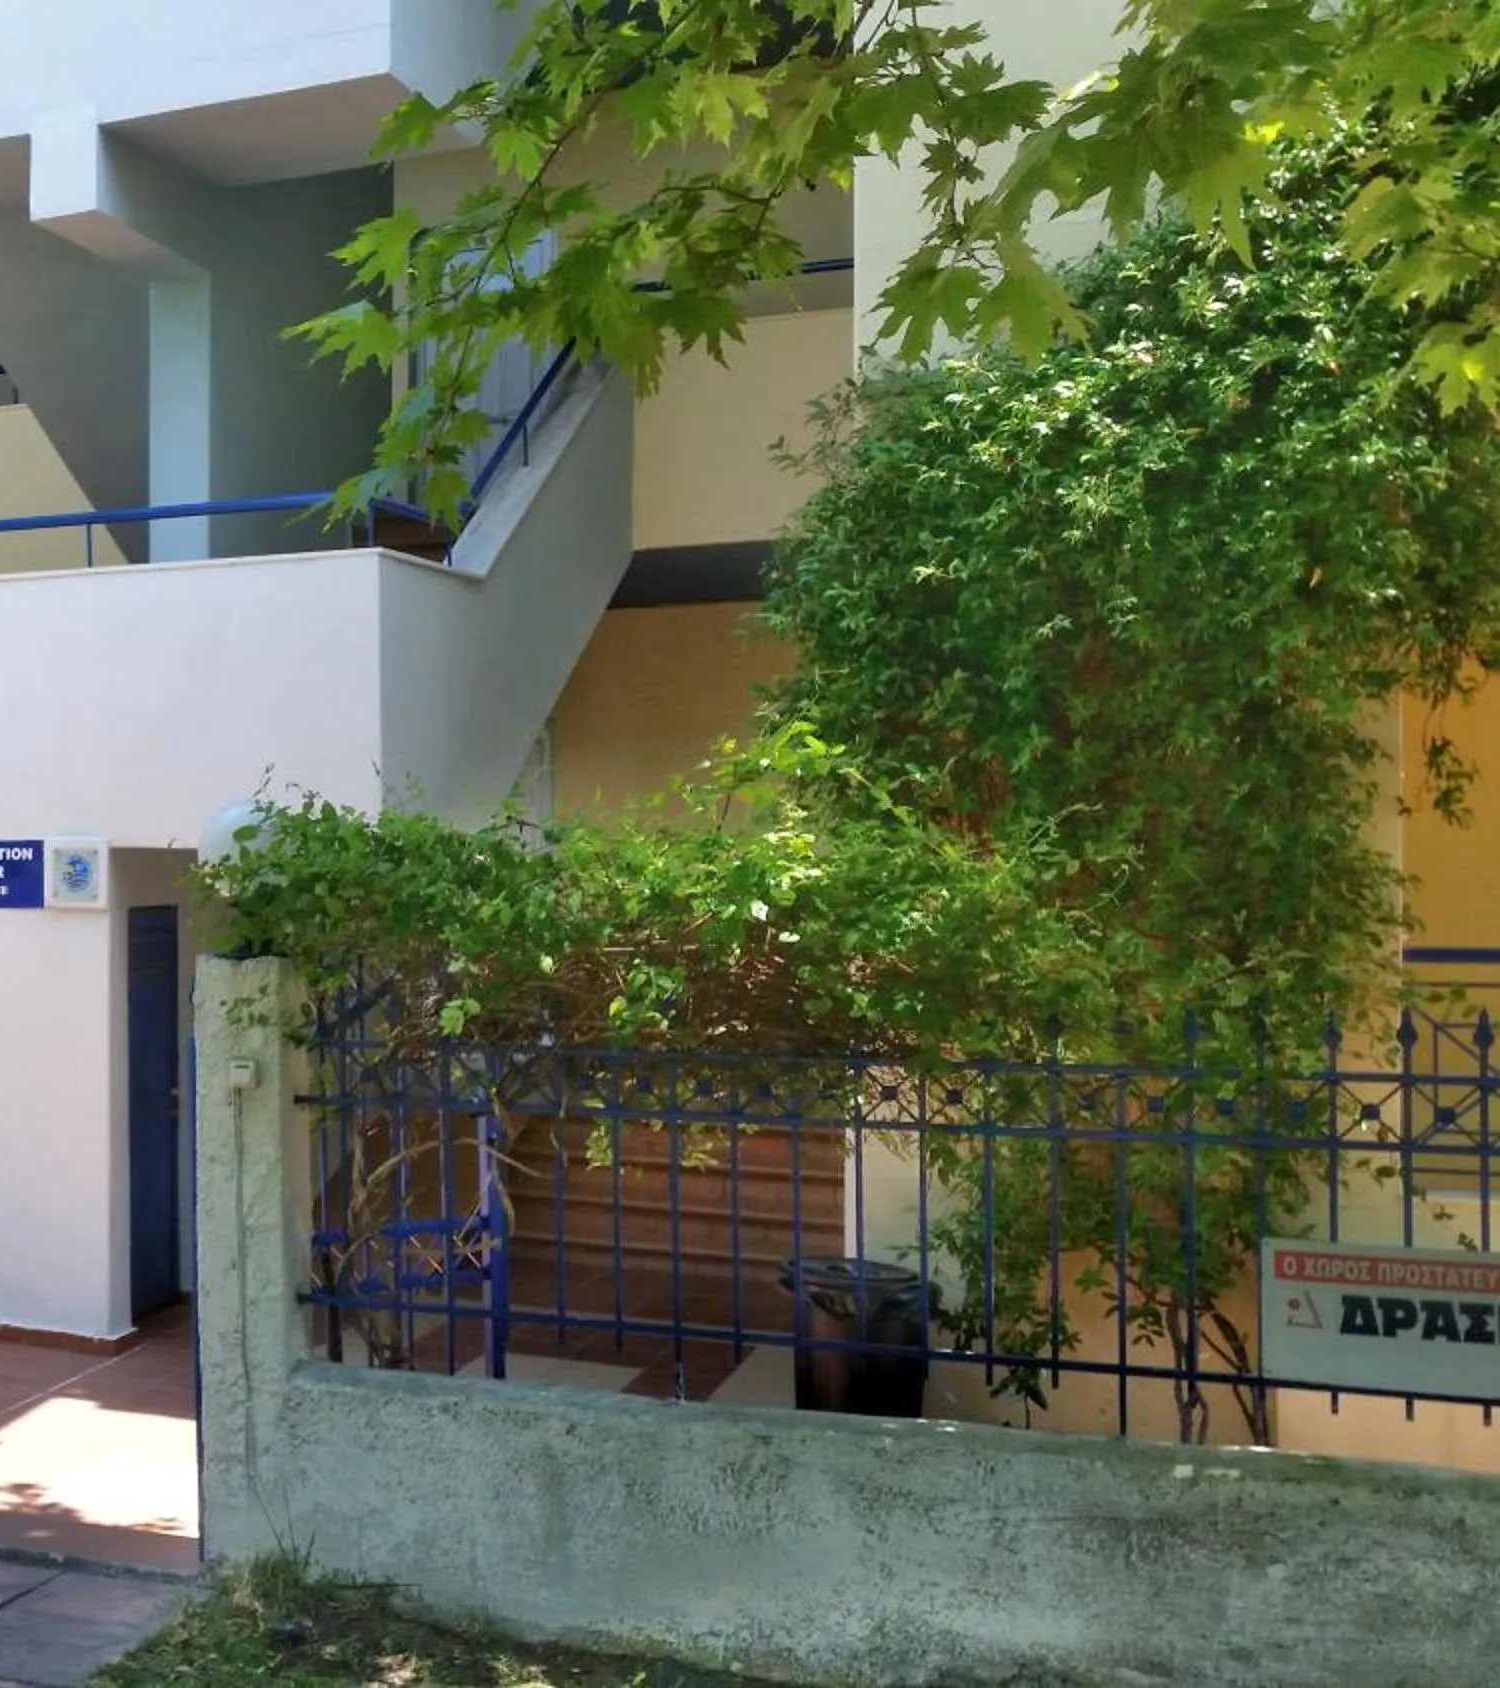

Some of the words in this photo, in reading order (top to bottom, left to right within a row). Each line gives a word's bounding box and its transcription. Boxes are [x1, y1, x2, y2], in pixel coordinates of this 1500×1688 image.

[1283, 1256, 1298, 1276] Ο
[1304, 1256, 1371, 1281] ΧΩΡΟΣ
[1339, 1294, 1500, 1345] ΔΡΑΣ
